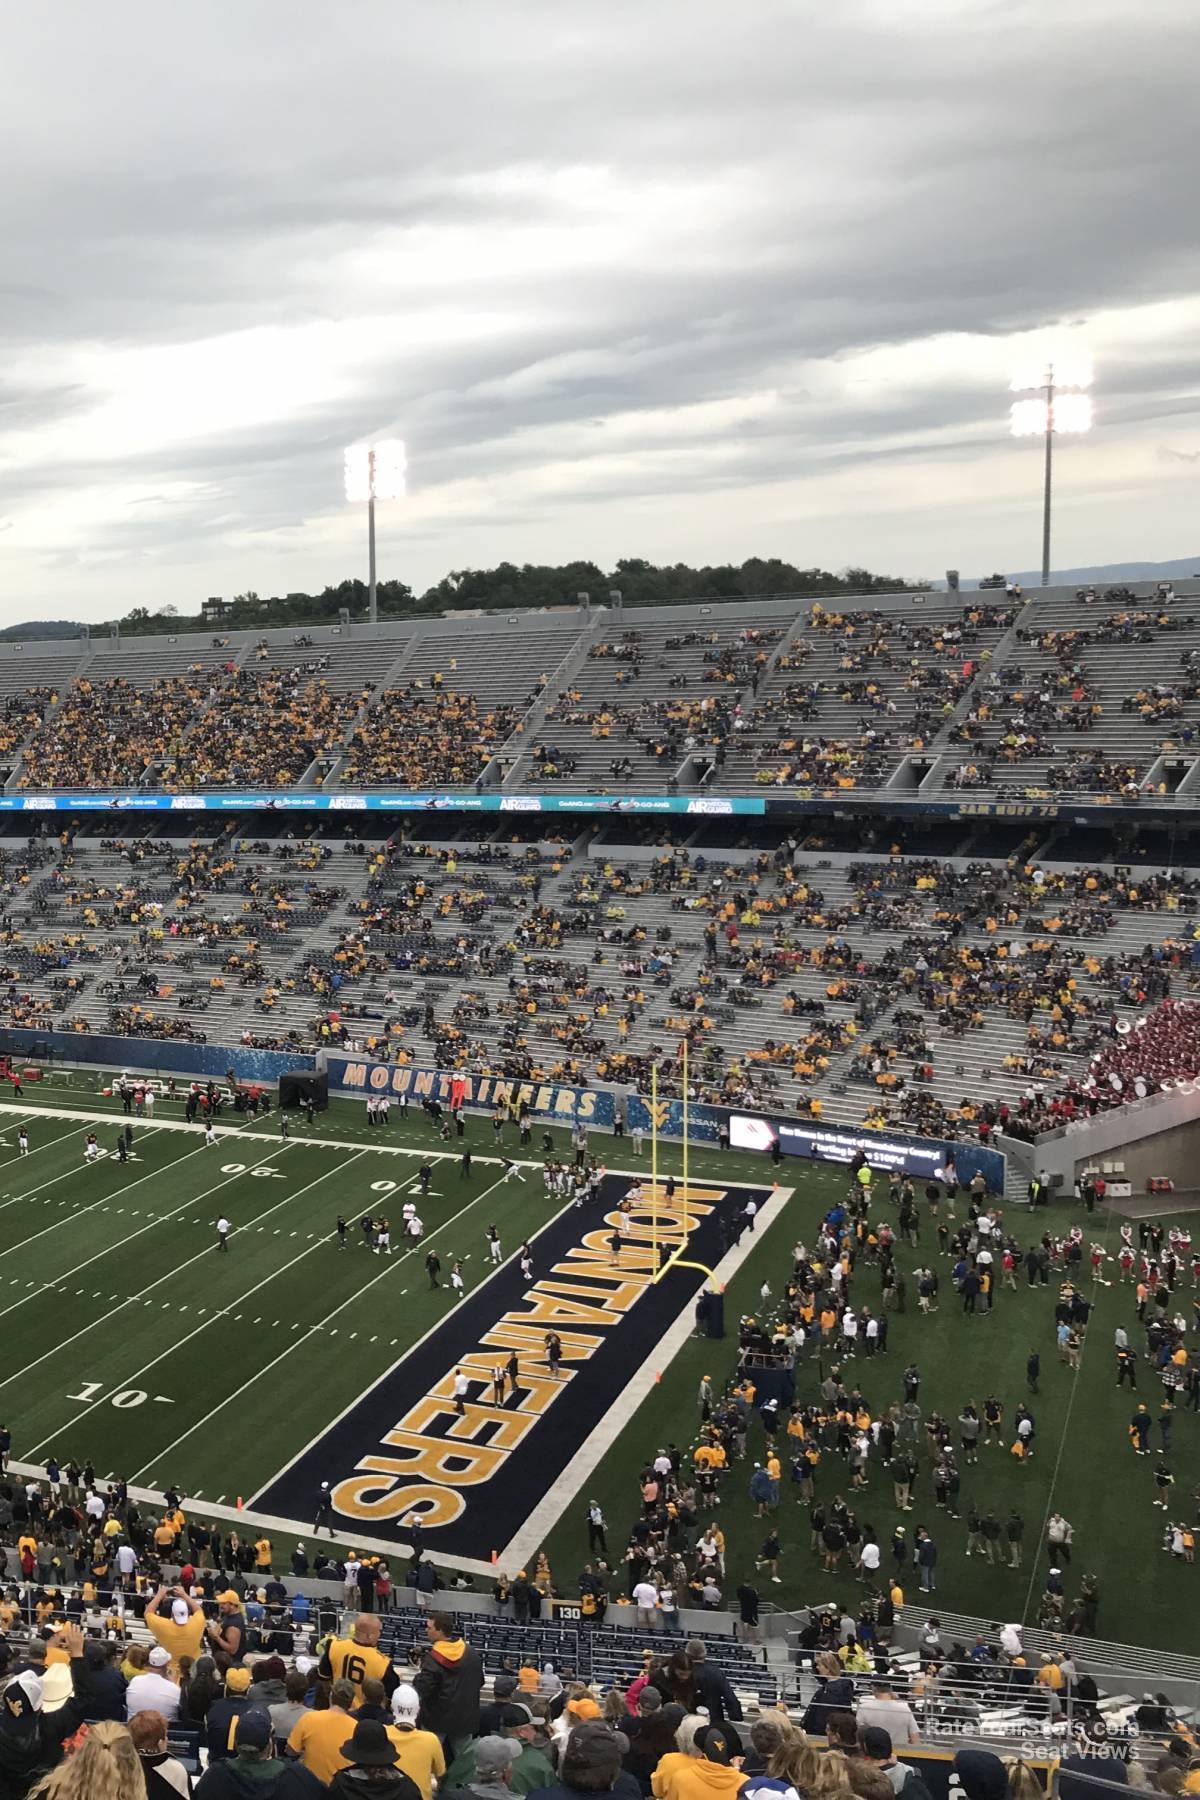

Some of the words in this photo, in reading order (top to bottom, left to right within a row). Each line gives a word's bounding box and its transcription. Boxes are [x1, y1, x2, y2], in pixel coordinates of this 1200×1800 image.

[329, 798, 346, 809] AIR
[500, 798, 518, 810] AIR
[687, 799, 708, 813] AIR
[959, 804, 989, 814] SAM
[996, 804, 1034, 816] HUFF
[1040, 806, 1058, 816] 75
[679, 1116, 719, 1129] NISSAN
[330, 1182, 728, 1530] MOUNTAINEERS
[65, 1380, 150, 1410] 10
[350, 1568, 358, 1579] 7
[560, 1606, 581, 1619] 130
[342, 1653, 367, 1685] 16
[397, 1705, 413, 1716] WV
